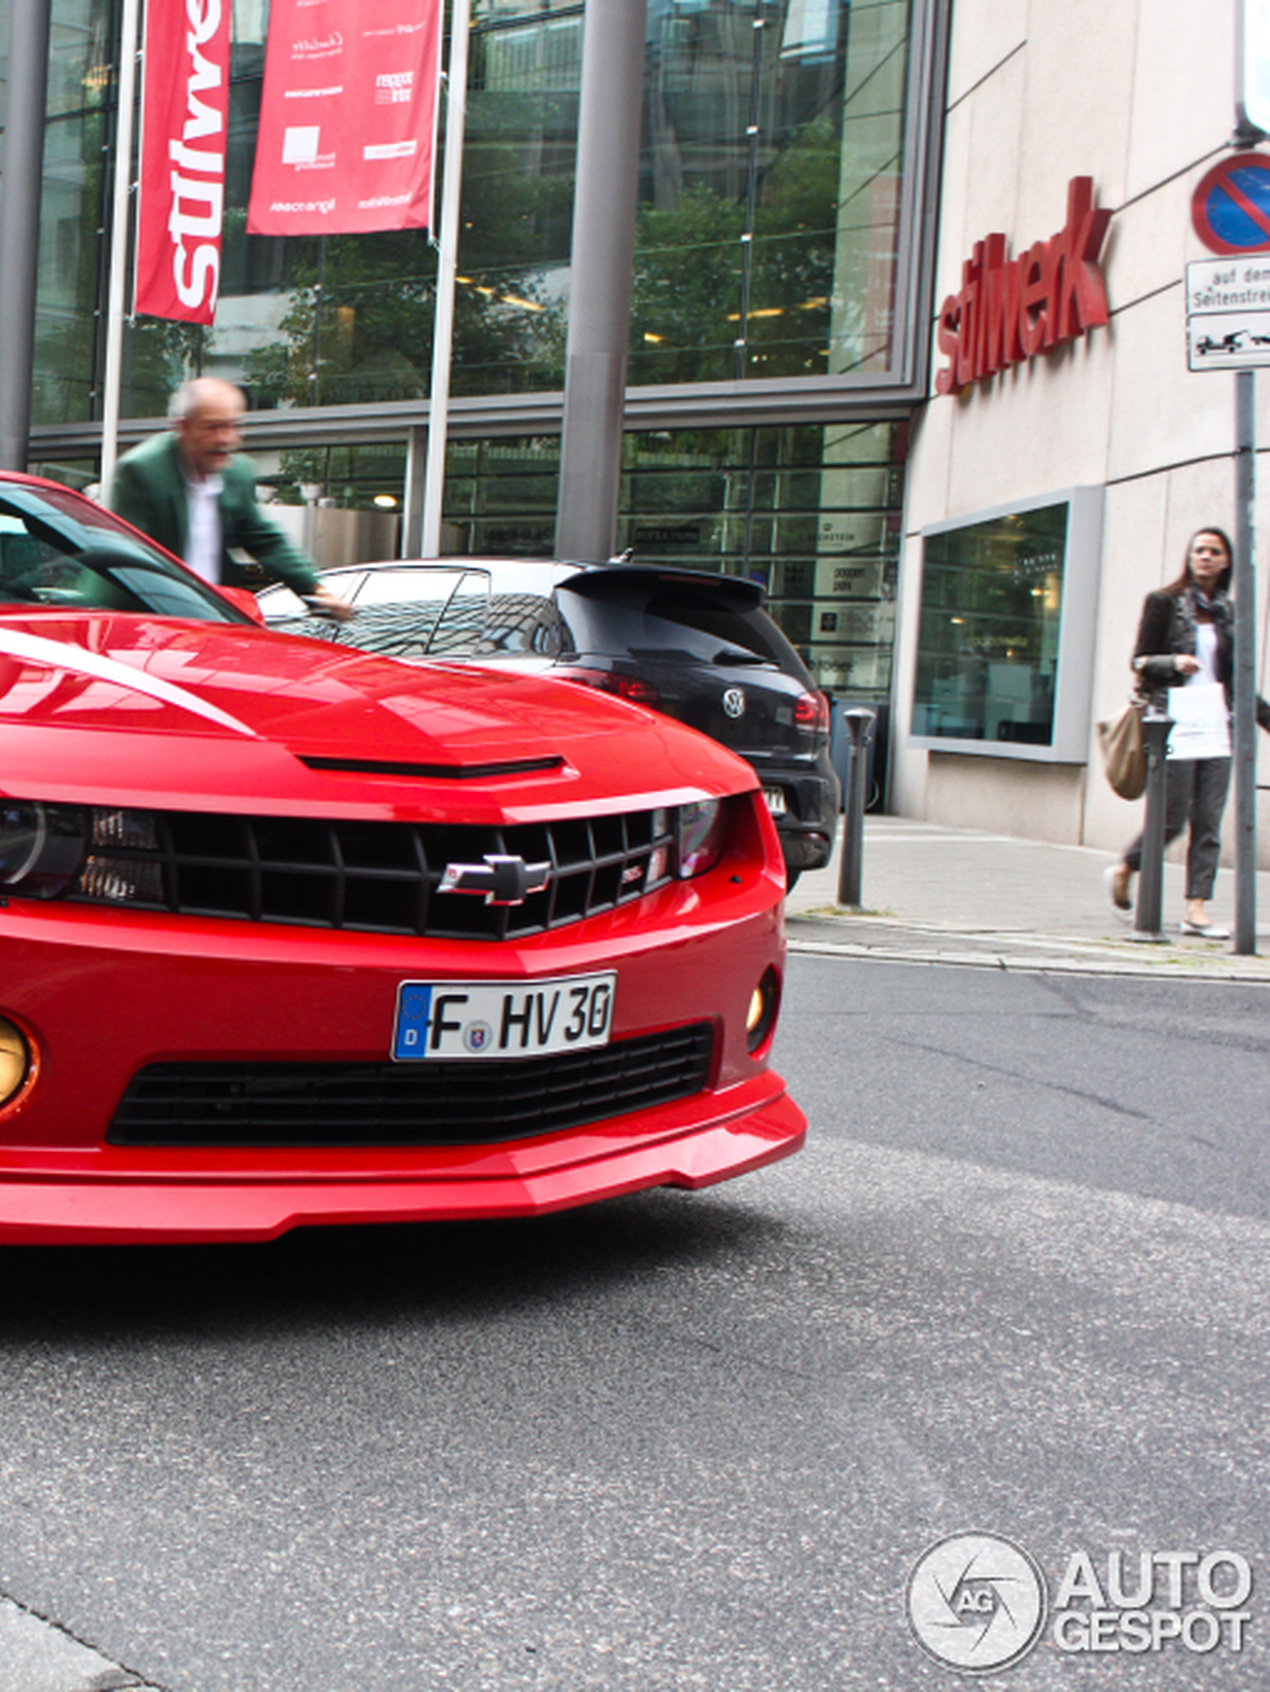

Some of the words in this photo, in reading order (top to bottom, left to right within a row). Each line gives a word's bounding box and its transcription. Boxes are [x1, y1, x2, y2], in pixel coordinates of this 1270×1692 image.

[935, 176, 1114, 395] stilwerk
[1213, 267, 1237, 285] auf
[431, 994, 469, 1050] F
[499, 990, 561, 1049] HV
[564, 983, 610, 1042] 30
